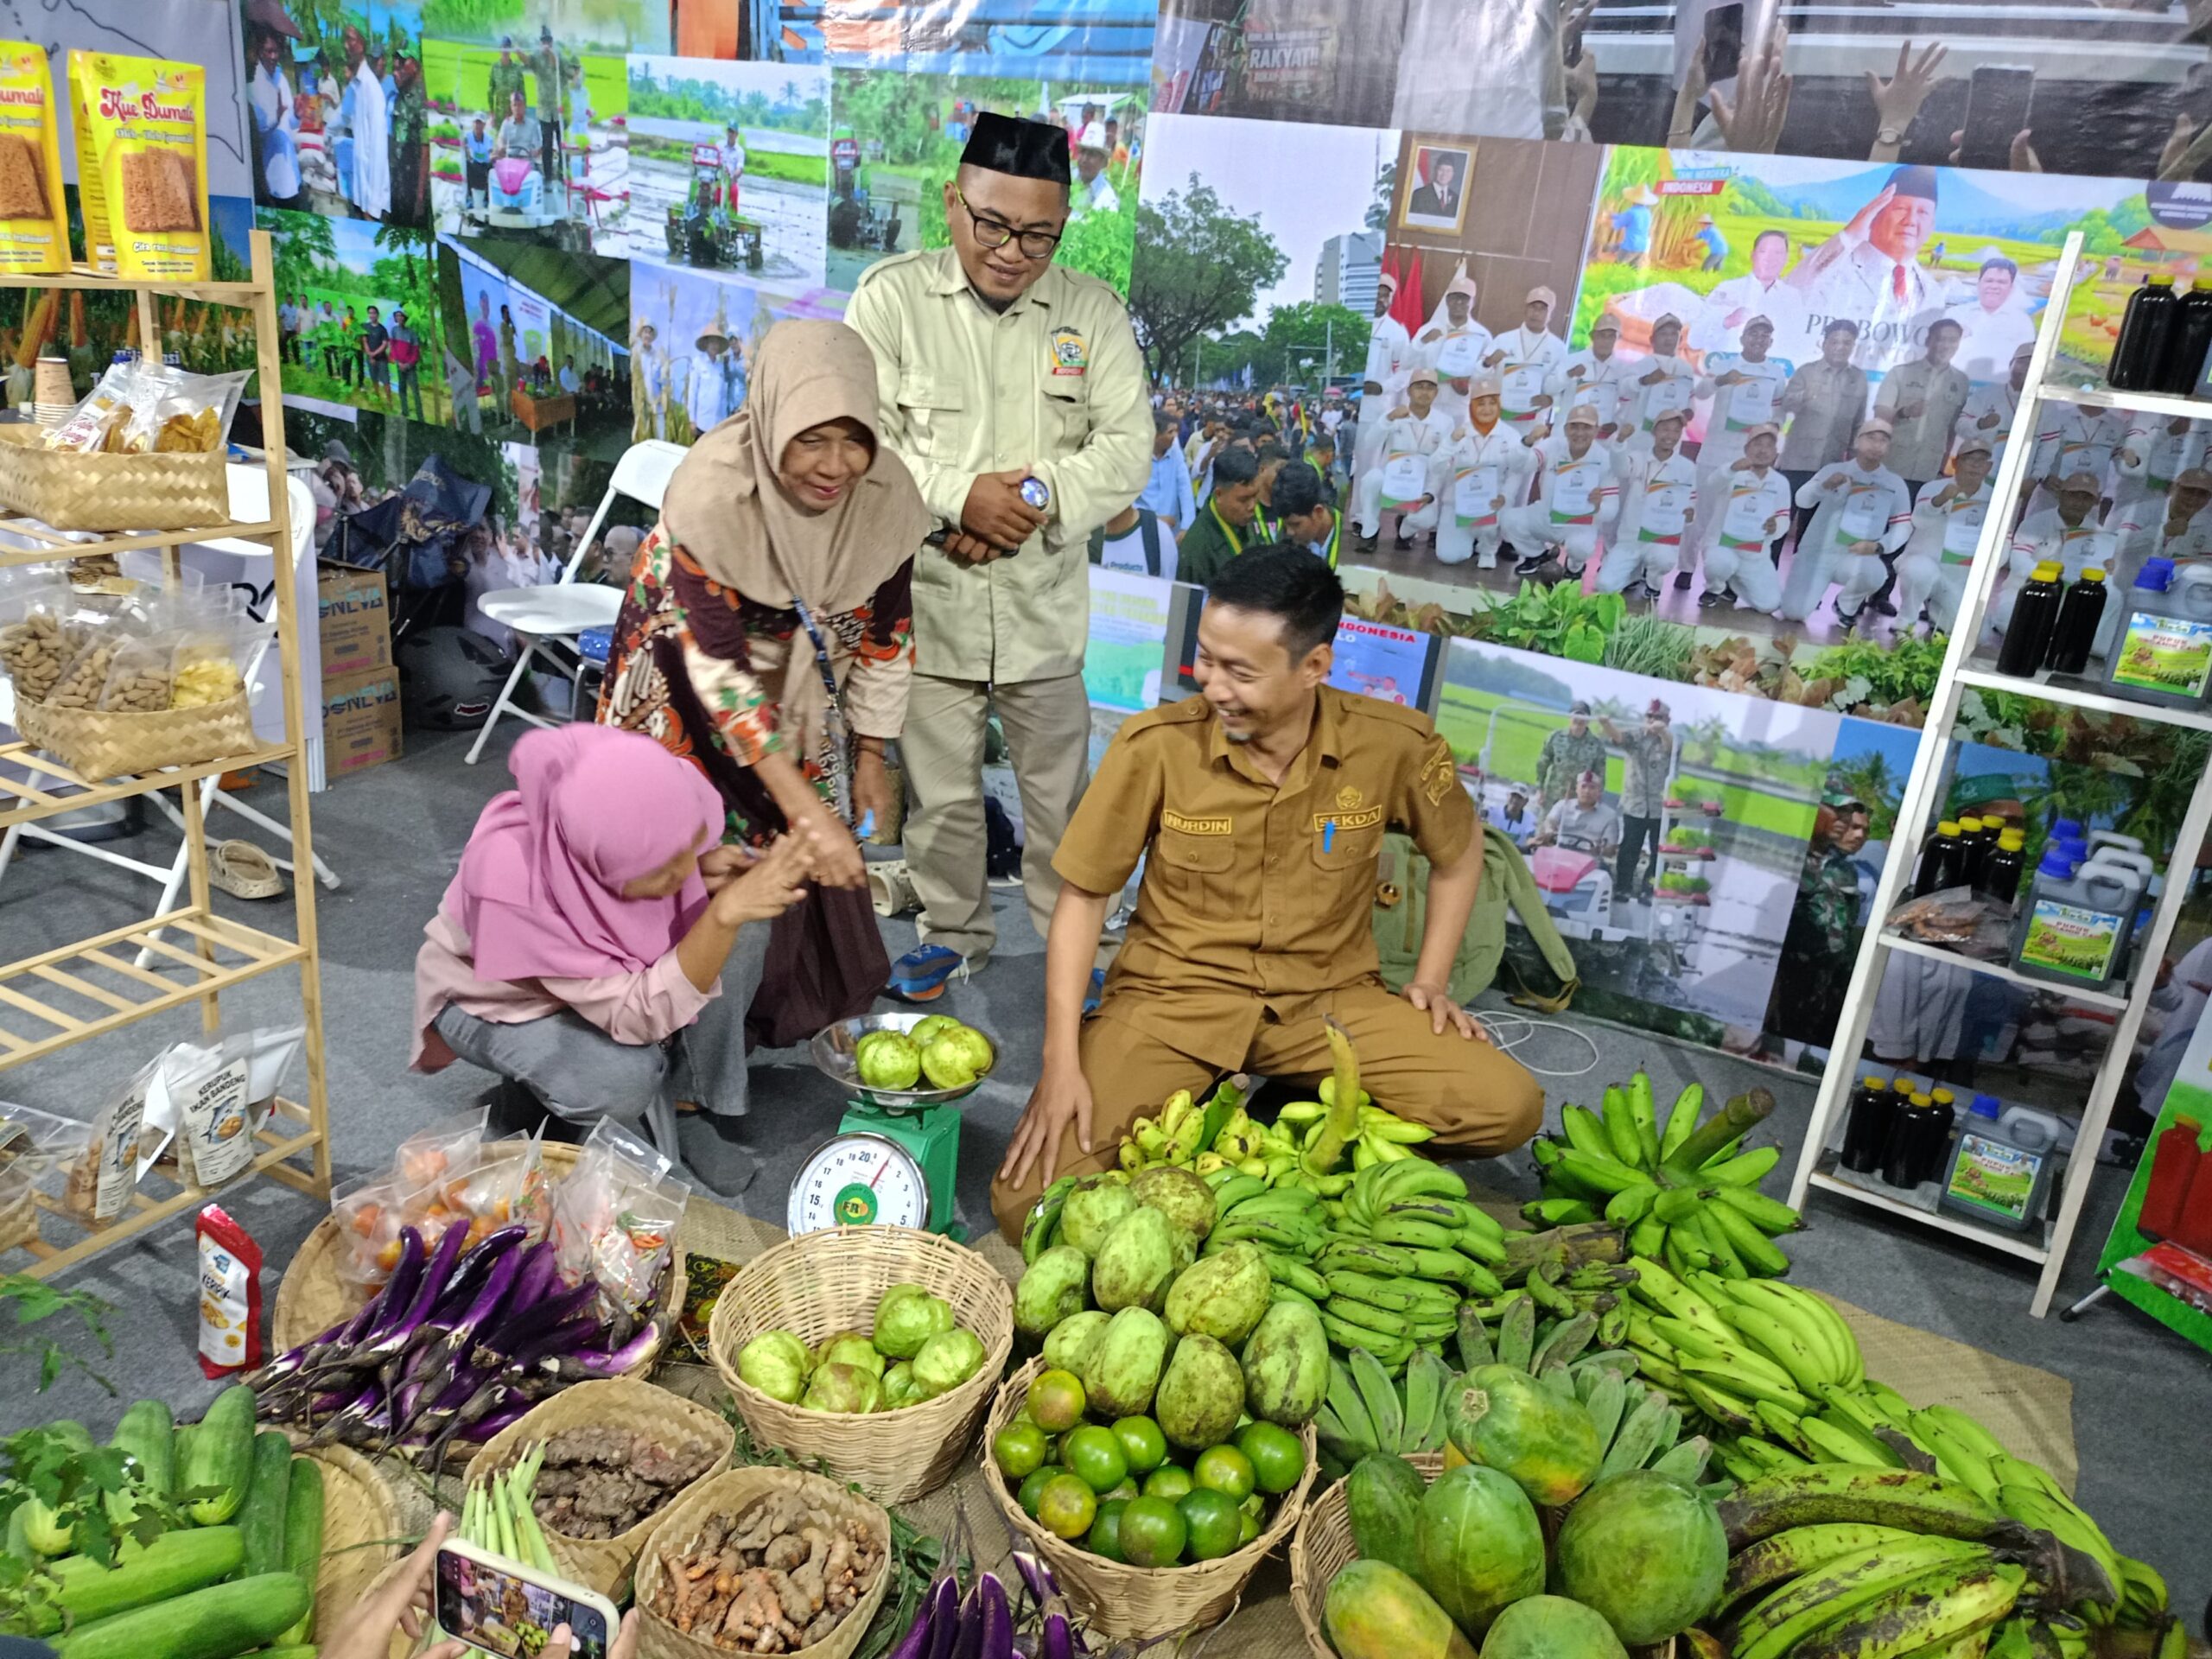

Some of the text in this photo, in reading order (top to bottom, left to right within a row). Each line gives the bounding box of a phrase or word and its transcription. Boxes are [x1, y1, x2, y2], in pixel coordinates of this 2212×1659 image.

[100, 88, 138, 122] Kue
[1662, 181, 1713, 194] INDONESIA
[1168, 815, 1228, 832] NURDIN
[1319, 812, 1377, 827] SEKDA
[198, 1070, 232, 1096] KERUPUK
[189, 1096, 210, 1114] IKAN
[210, 1074, 246, 1098] BANDENG
[836, 1158, 843, 1166] 18
[849, 1153, 856, 1161] 19
[858, 1151, 871, 1163] 20
[823, 1167, 831, 1176] 17
[815, 1179, 823, 1188] 16
[810, 1193, 820, 1206] 15
[808, 1211, 816, 1220] 14
[900, 1215, 906, 1225] 5
